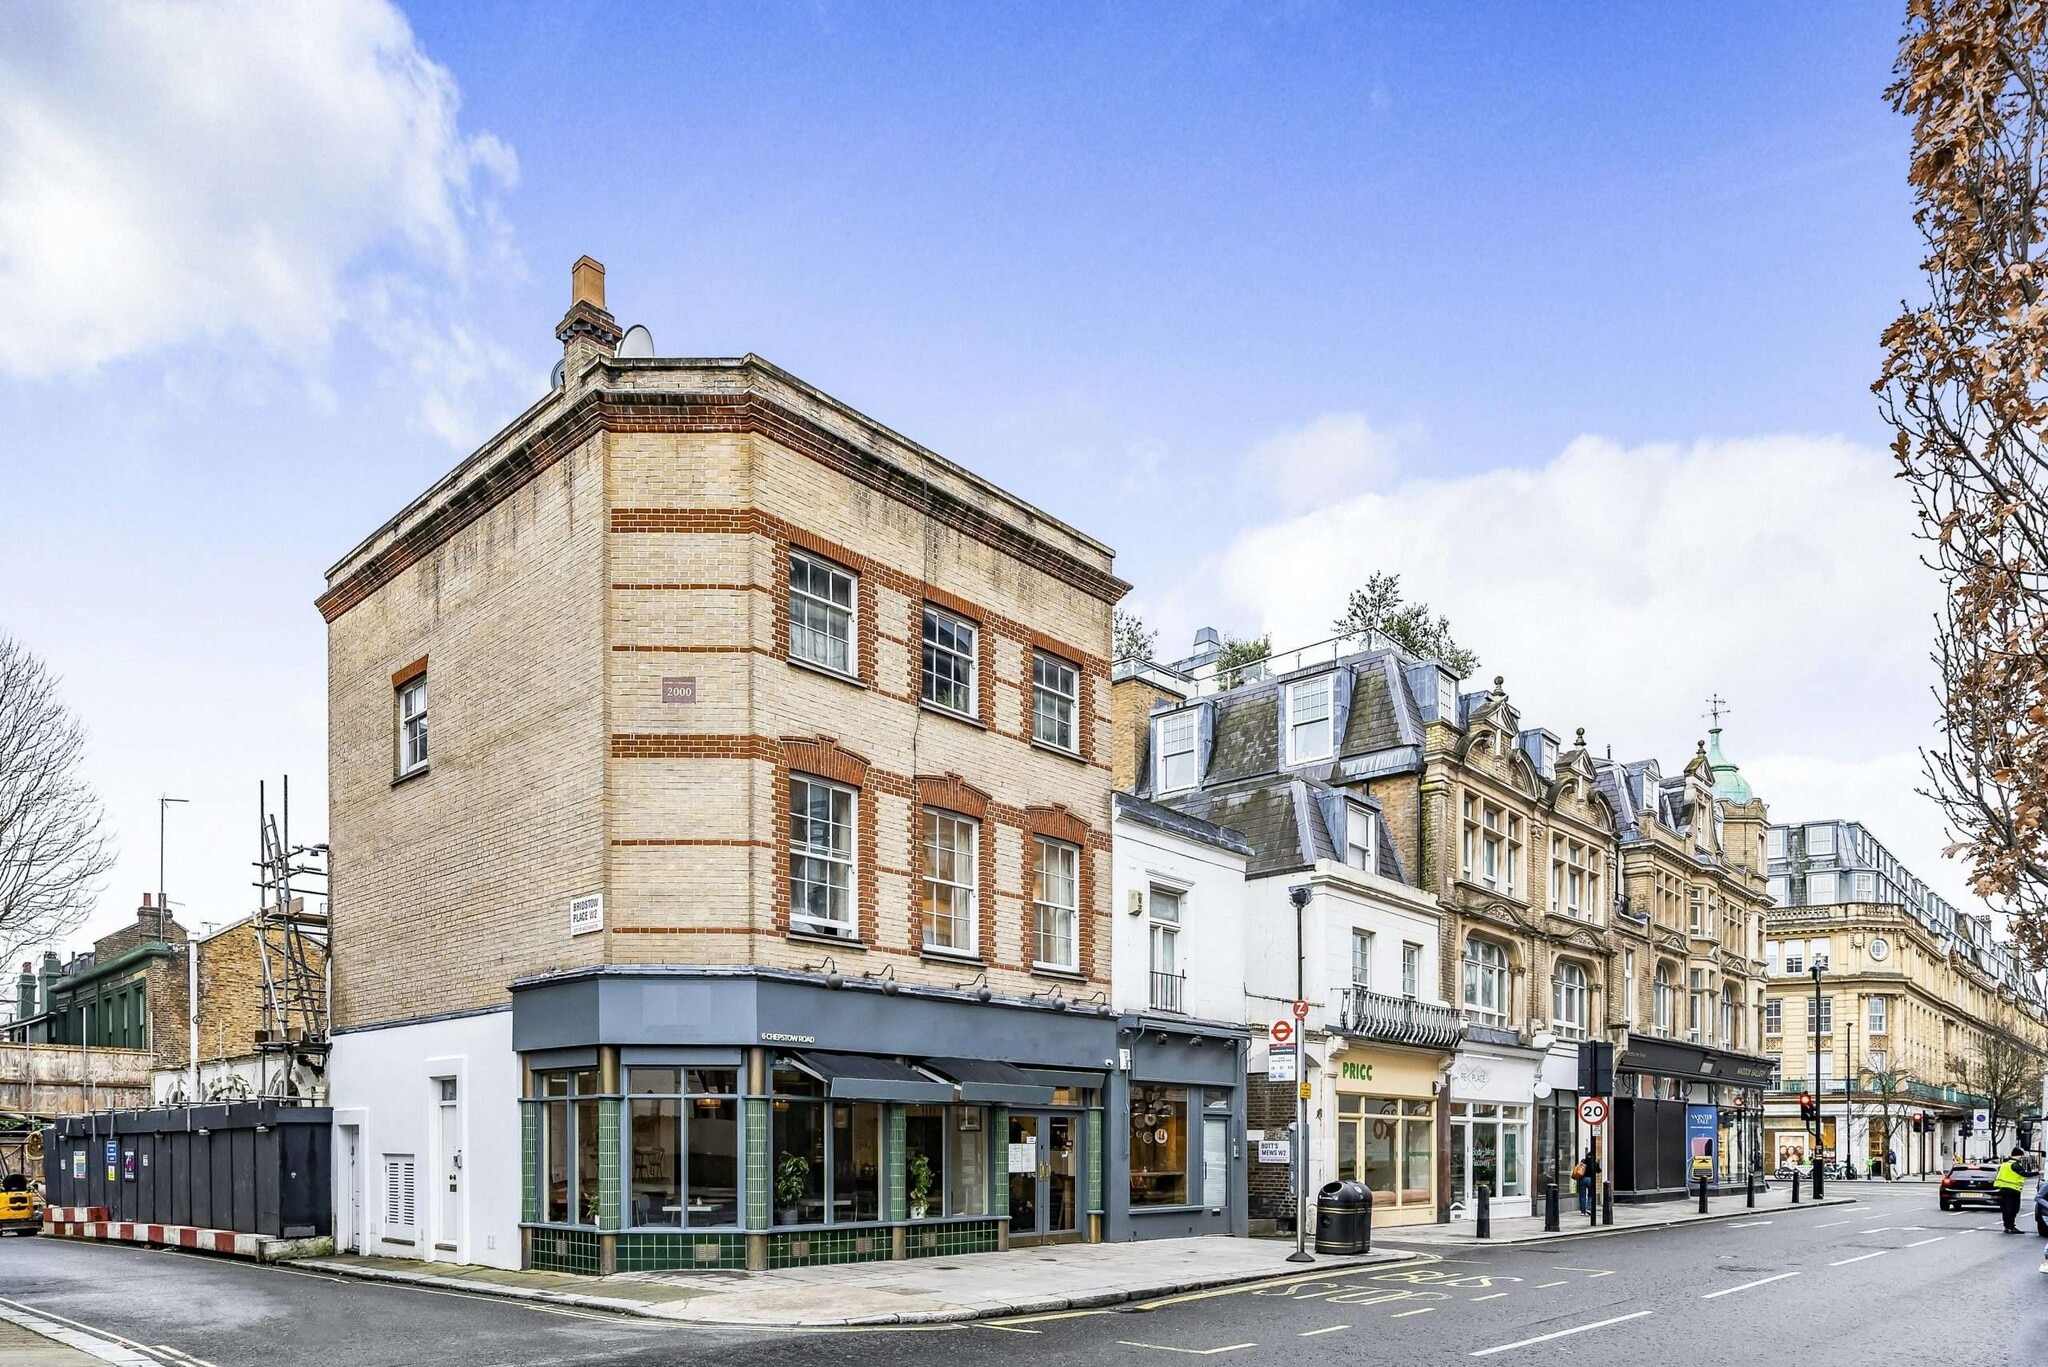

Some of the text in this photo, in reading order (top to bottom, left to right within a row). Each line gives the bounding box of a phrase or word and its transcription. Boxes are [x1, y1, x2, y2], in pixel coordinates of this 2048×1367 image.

[667, 687, 692, 697] 2000
[573, 898, 599, 912] BRIDSTOW
[573, 909, 598, 923] PLACE W2
[1296, 1002, 1305, 1015] Z
[761, 1032, 815, 1043] 6 CHEPSTOW ROAD
[1342, 1061, 1373, 1081] PRICC
[1583, 1105, 1603, 1117] 20
[1369, 1270, 1524, 1288] BUS
[1252, 1283, 1453, 1305] STOP
